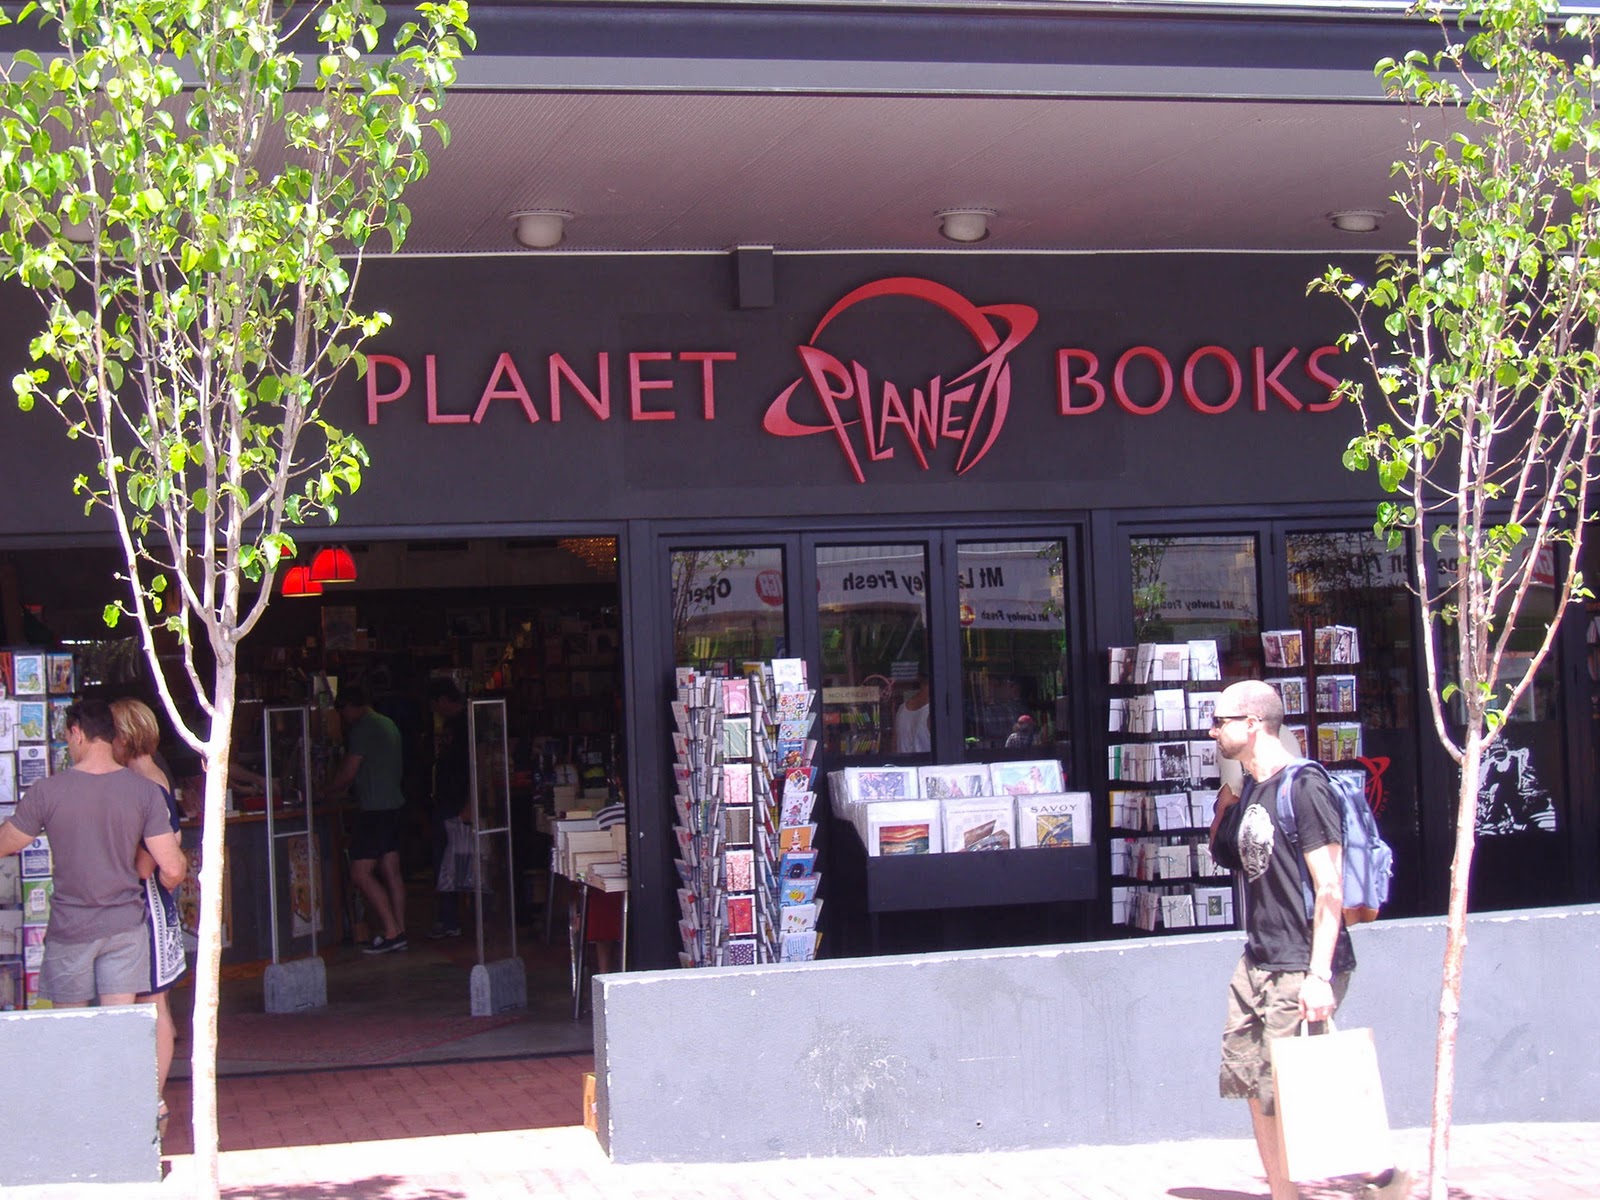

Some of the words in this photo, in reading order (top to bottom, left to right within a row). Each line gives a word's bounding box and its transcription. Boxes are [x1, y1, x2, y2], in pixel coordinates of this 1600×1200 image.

[365, 351, 737, 425] PLANET
[797, 344, 1012, 483] PLANET
[1056, 345, 1344, 416] BOOKS
[1030, 804, 1078, 814] SAVOY
